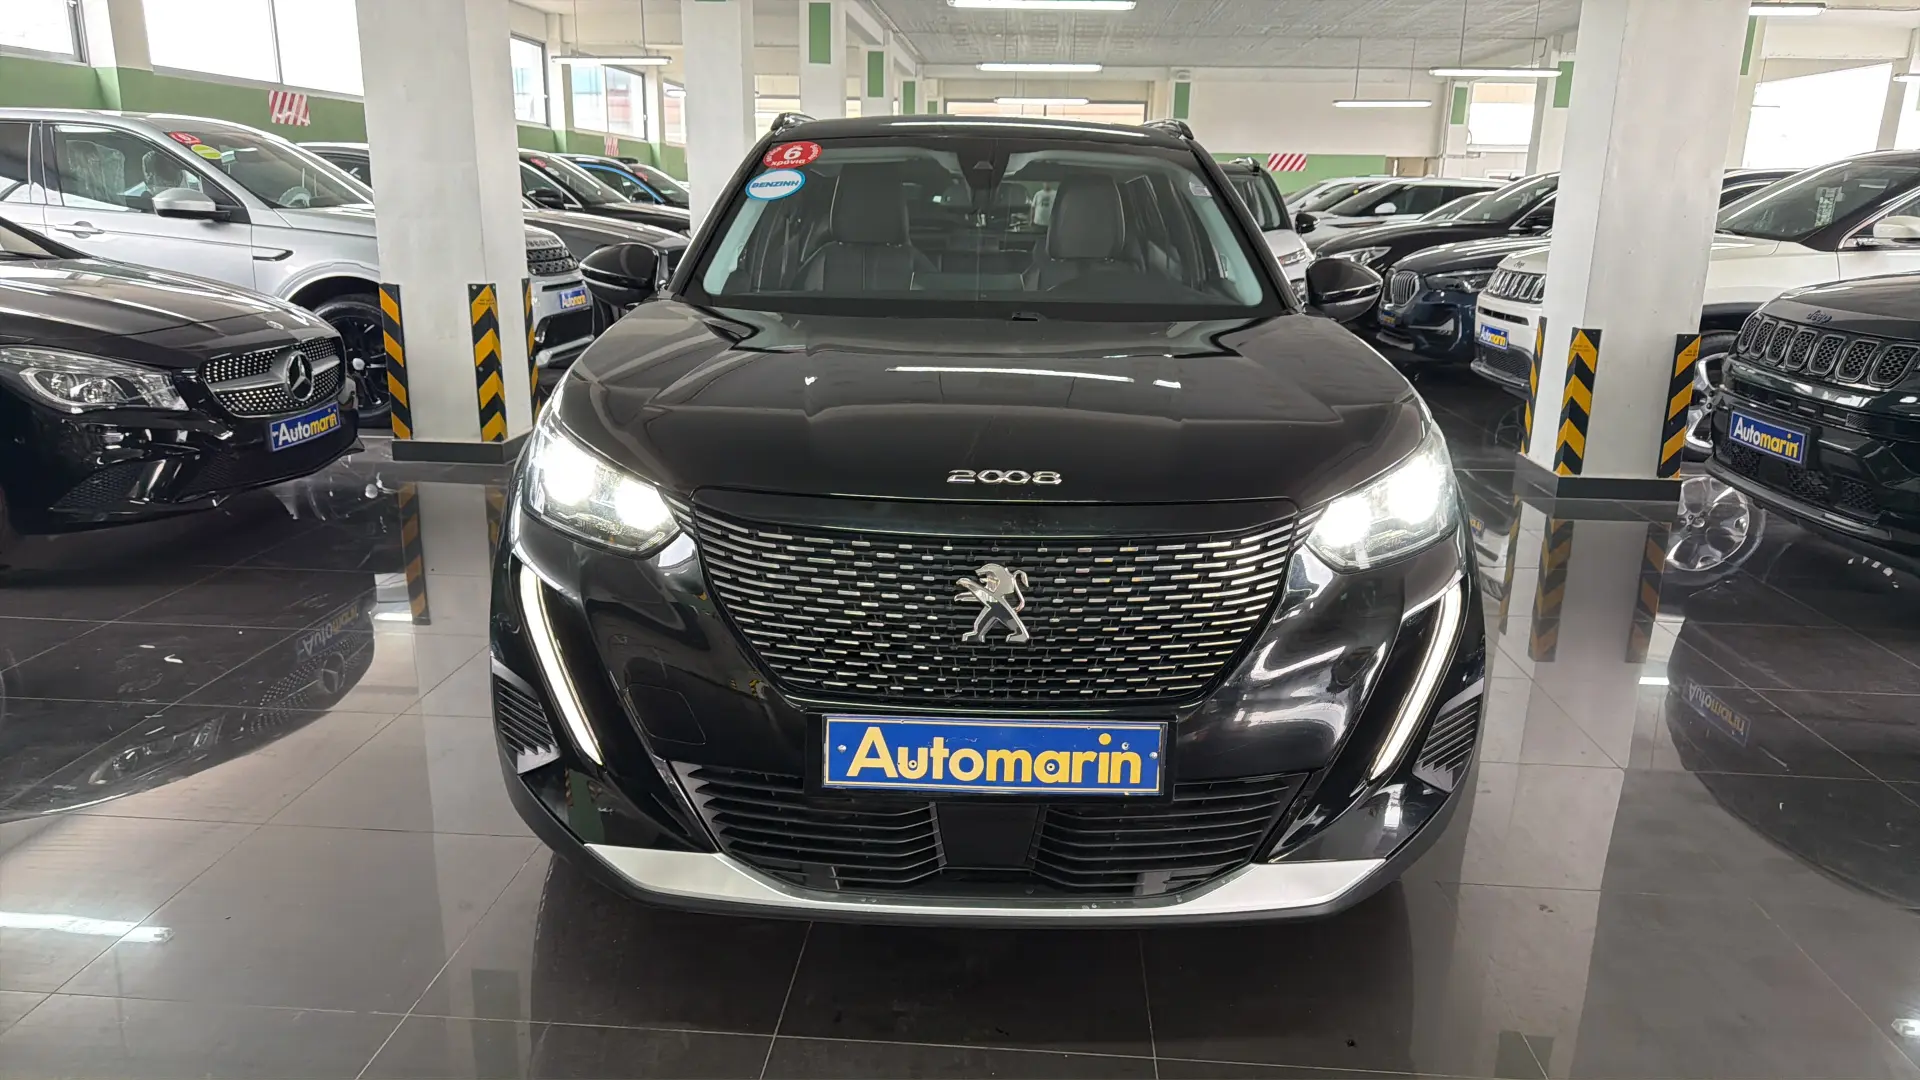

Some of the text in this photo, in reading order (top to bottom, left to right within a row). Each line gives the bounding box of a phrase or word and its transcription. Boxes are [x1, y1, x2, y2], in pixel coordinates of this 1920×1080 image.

[784, 146, 804, 160] 6
[278, 408, 339, 446] Automarin
[1732, 416, 1800, 459] Automarin
[946, 468, 1063, 485] 2008
[846, 726, 1142, 784] Automarin
